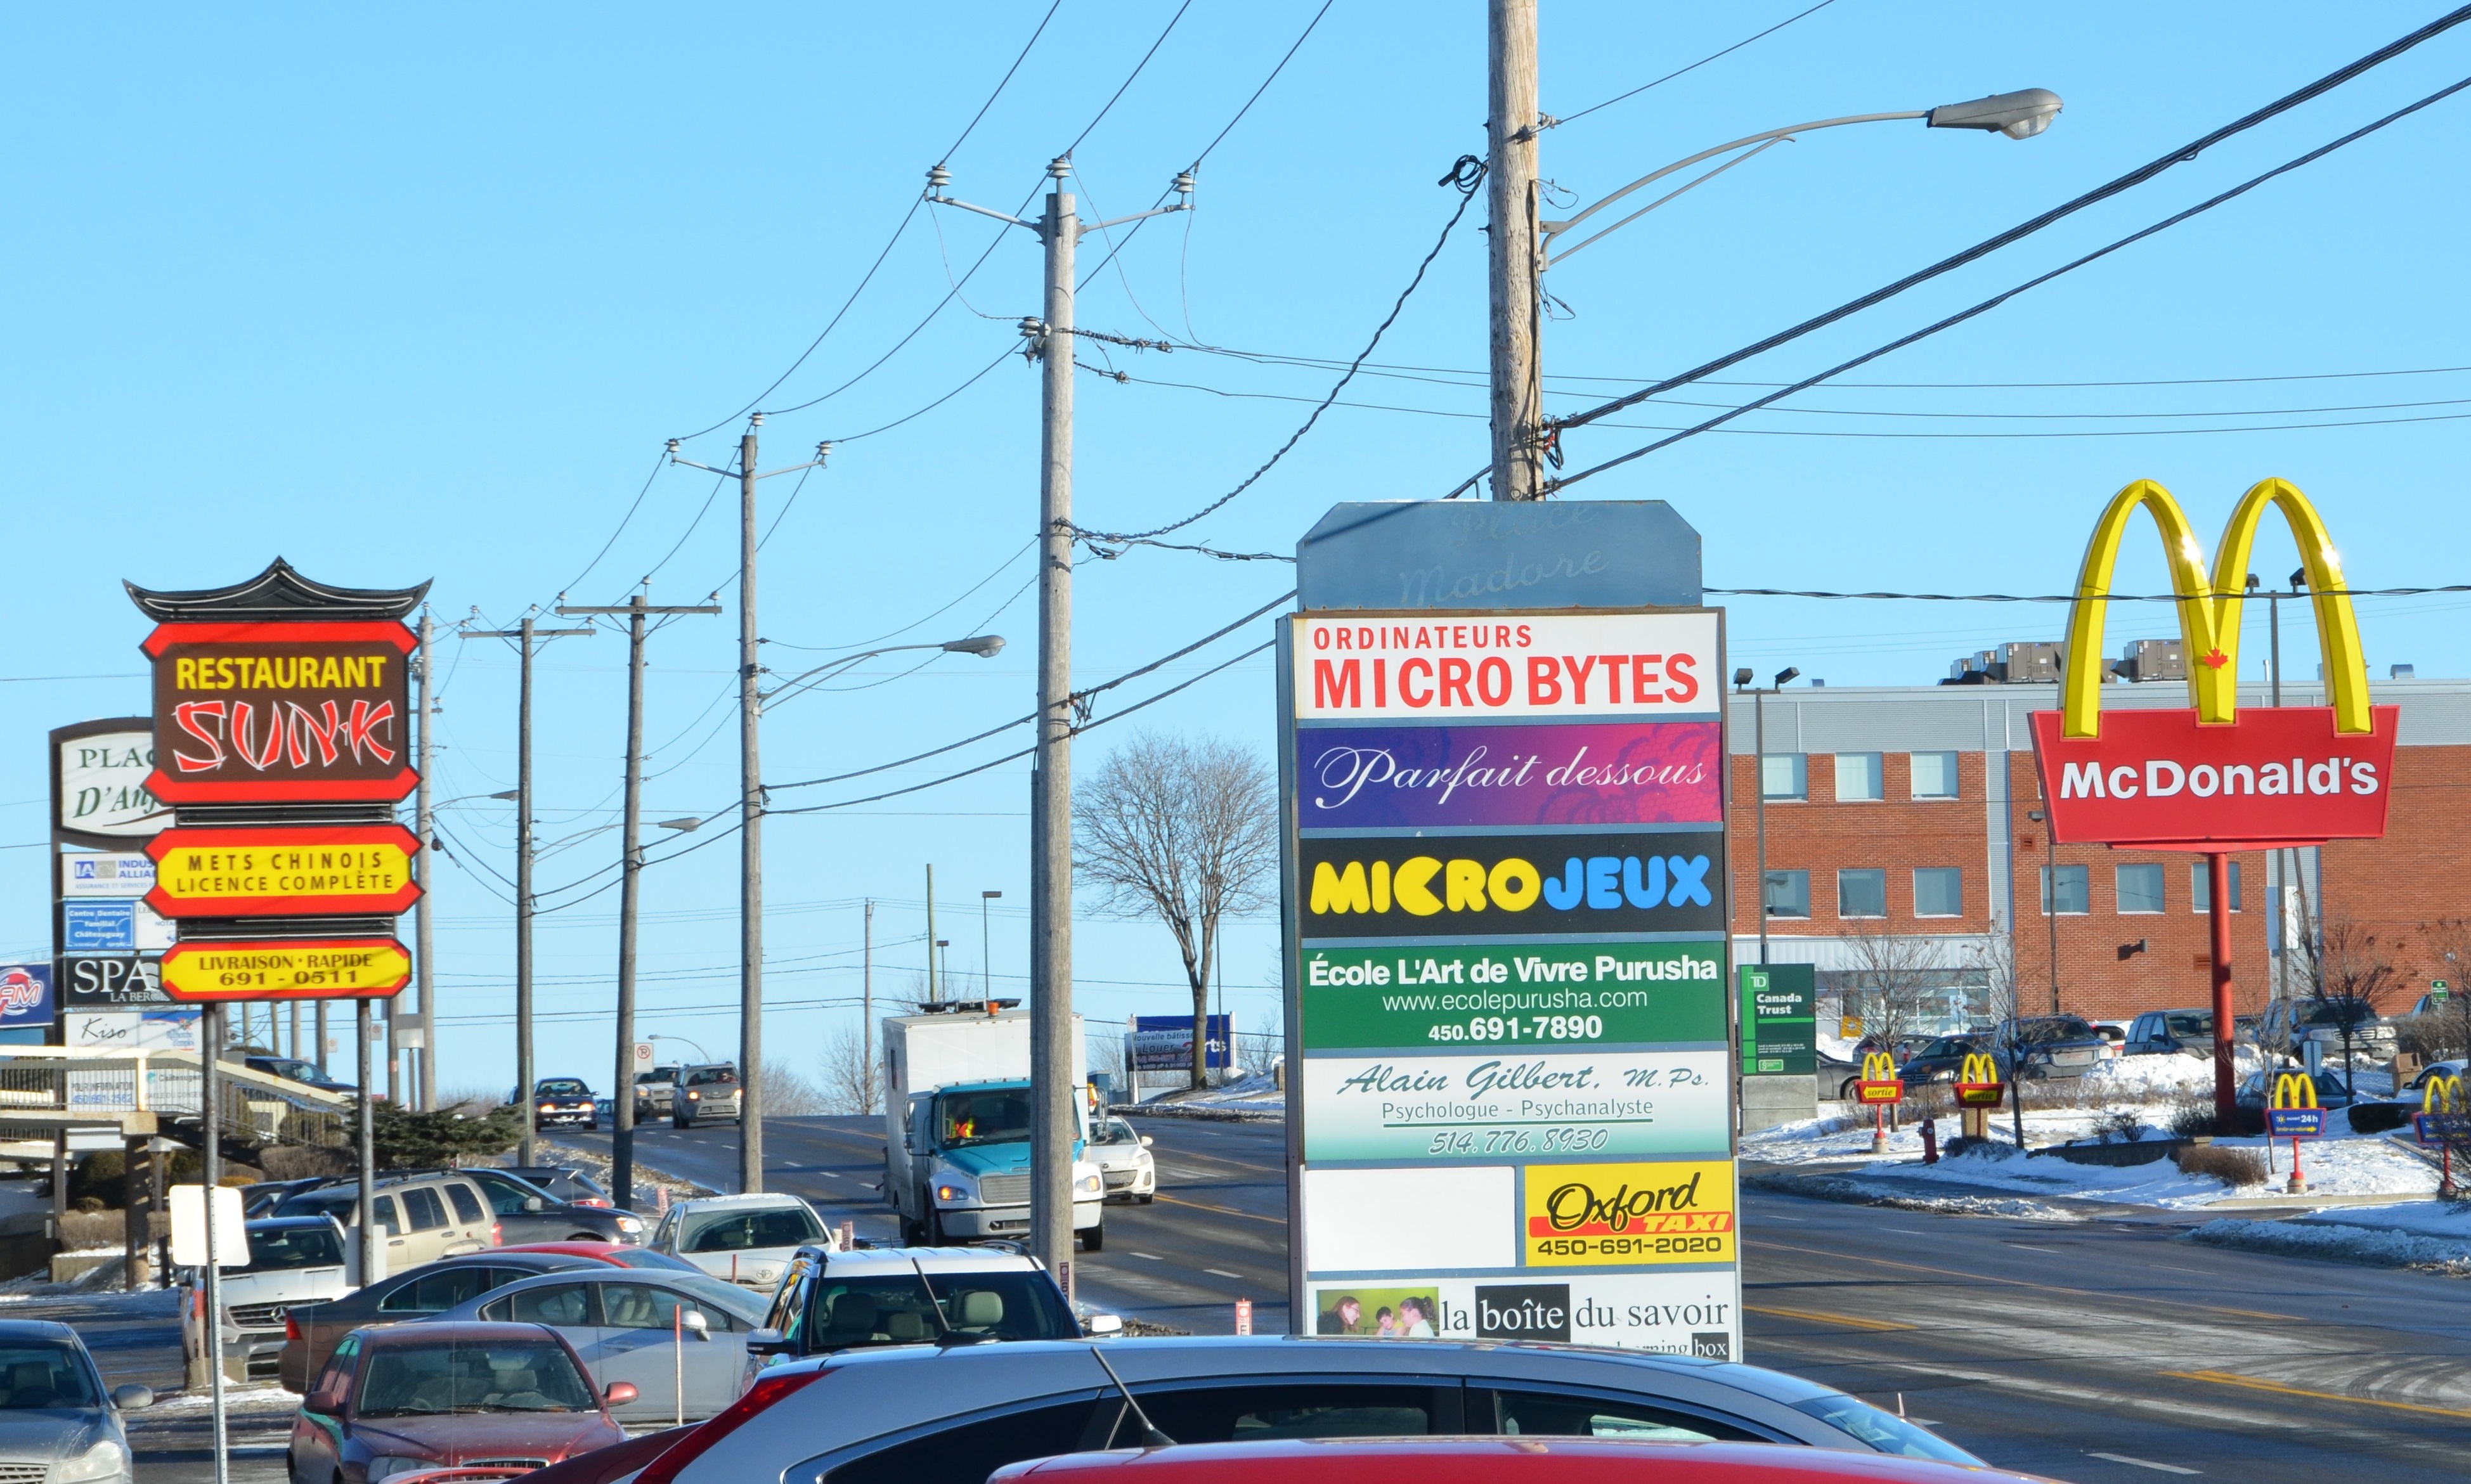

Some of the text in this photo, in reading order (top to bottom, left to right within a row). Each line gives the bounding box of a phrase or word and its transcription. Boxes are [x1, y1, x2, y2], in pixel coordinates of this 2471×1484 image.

[1399, 550, 1611, 607] Madore
[1313, 625, 1532, 650] ORDINATEURS
[176, 656, 387, 690] RESTAURANT
[1314, 653, 1699, 709] MICRO BYTES
[1314, 745, 1708, 810] Parfait dessous
[2060, 758, 2379, 799] McDonald's
[188, 852, 381, 871] METS CHINOIS
[119, 870, 155, 879] ALLIA
[177, 871, 393, 893] LICENCE COMPLÈTE
[199, 954, 373, 971] LIVRAISON RAPIDE
[1309, 953, 1718, 986] École L'Art de Vivre Purusha
[74, 959, 153, 993] SPA
[219, 971, 265, 986] 691
[294, 970, 356, 984] 0511
[110, 993, 127, 1002] LA
[1382, 988, 1648, 1014] www.ecolepurusha.com
[1756, 993, 1802, 1003] Canada
[1757, 1005, 1792, 1014] Trust
[82, 1018, 126, 1038] Kiso
[1428, 1016, 1603, 1042] 450.691-7890
[1143, 1043, 1174, 1053] Louer
[90, 1081, 133, 1091] INFORMATION
[1336, 1063, 1450, 1095] Alain
[1465, 1061, 1600, 1100] Gilbert,
[1867, 1087, 1893, 1097] sortie
[1967, 1090, 1993, 1100] sortie
[1382, 1100, 1498, 1121] Psychologue
[1522, 1098, 1654, 1118] Psychanalyste
[1546, 1171, 1701, 1232] Oxford
[1642, 1213, 1732, 1234] TAXI
[1538, 1237, 1722, 1256] 450-691-2020
[1441, 1294, 1729, 1331] la boîte du savoir
